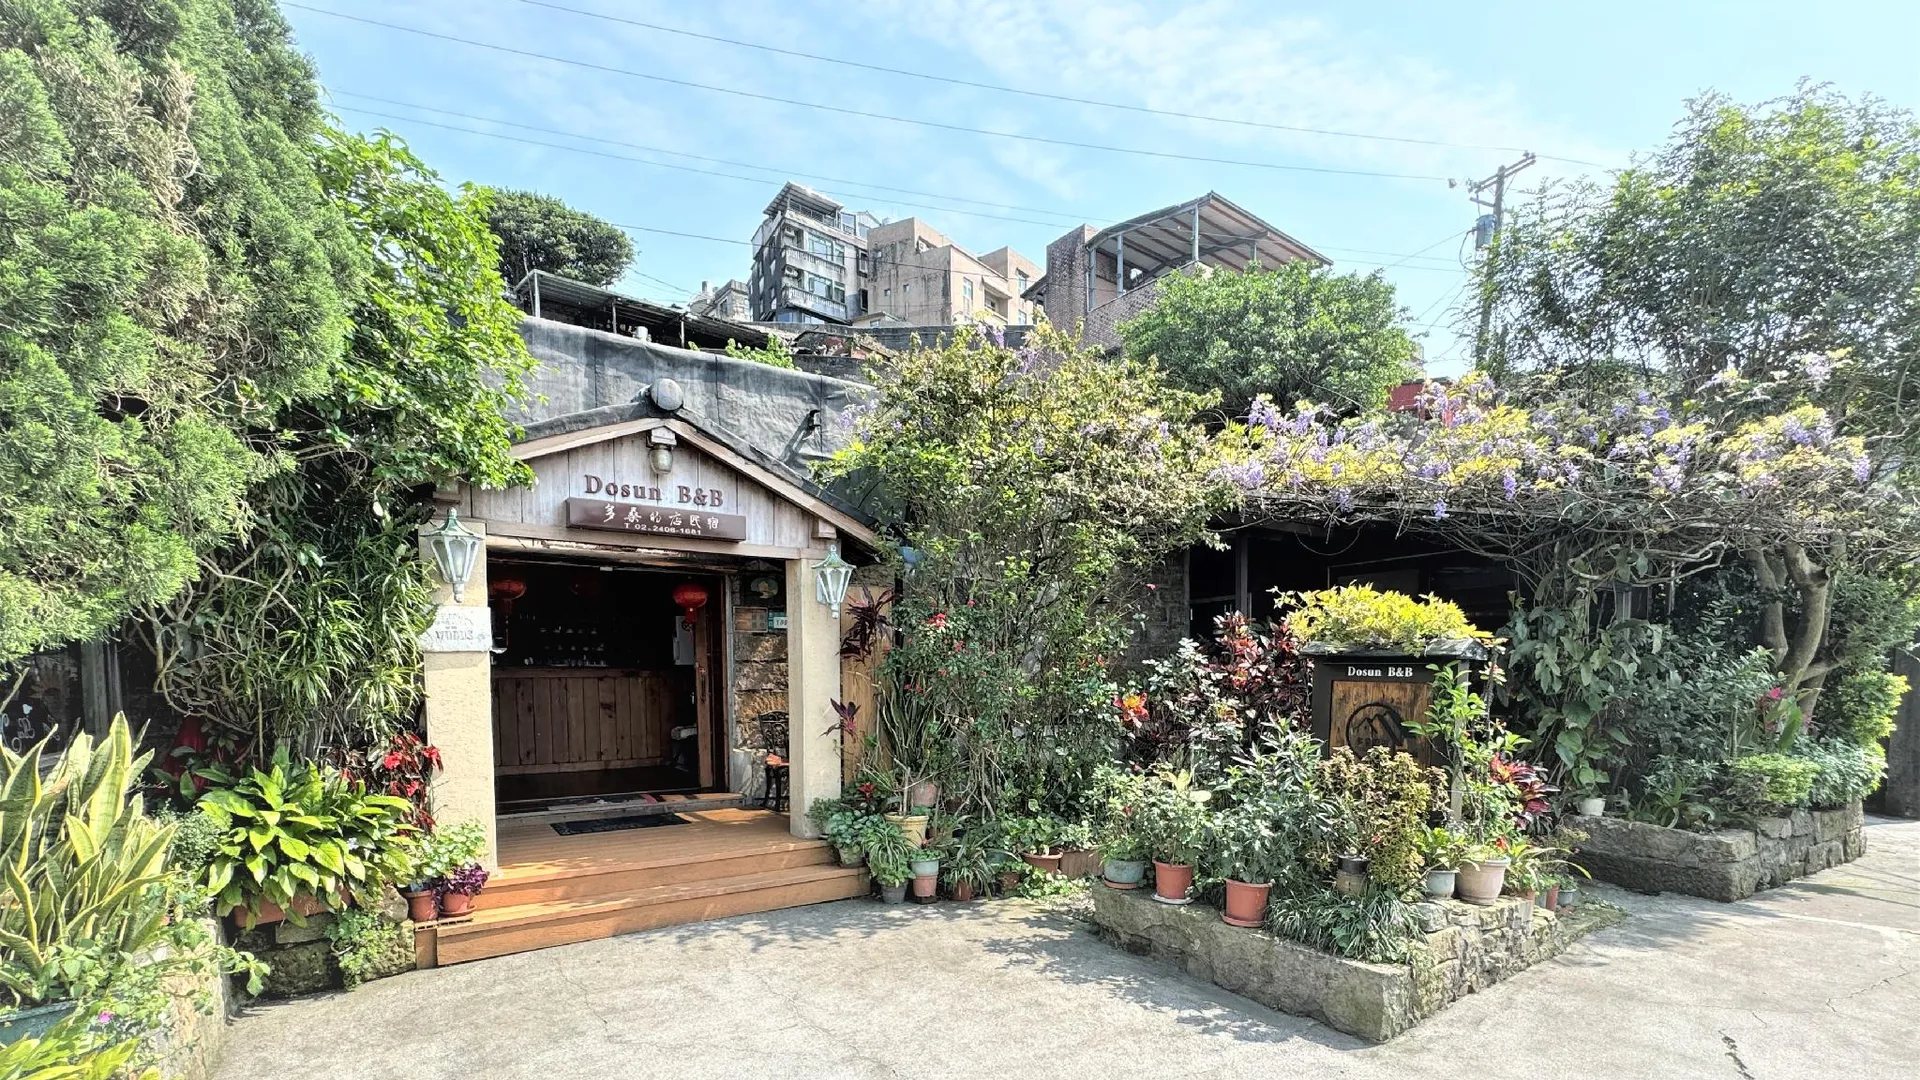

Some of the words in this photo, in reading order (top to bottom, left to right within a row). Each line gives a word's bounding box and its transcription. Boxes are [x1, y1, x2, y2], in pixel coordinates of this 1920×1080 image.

[585, 474, 662, 501] Dosun
[677, 485, 723, 507] B&B
[1347, 666, 1382, 677] Dosun
[1388, 667, 1413, 677] B&B
